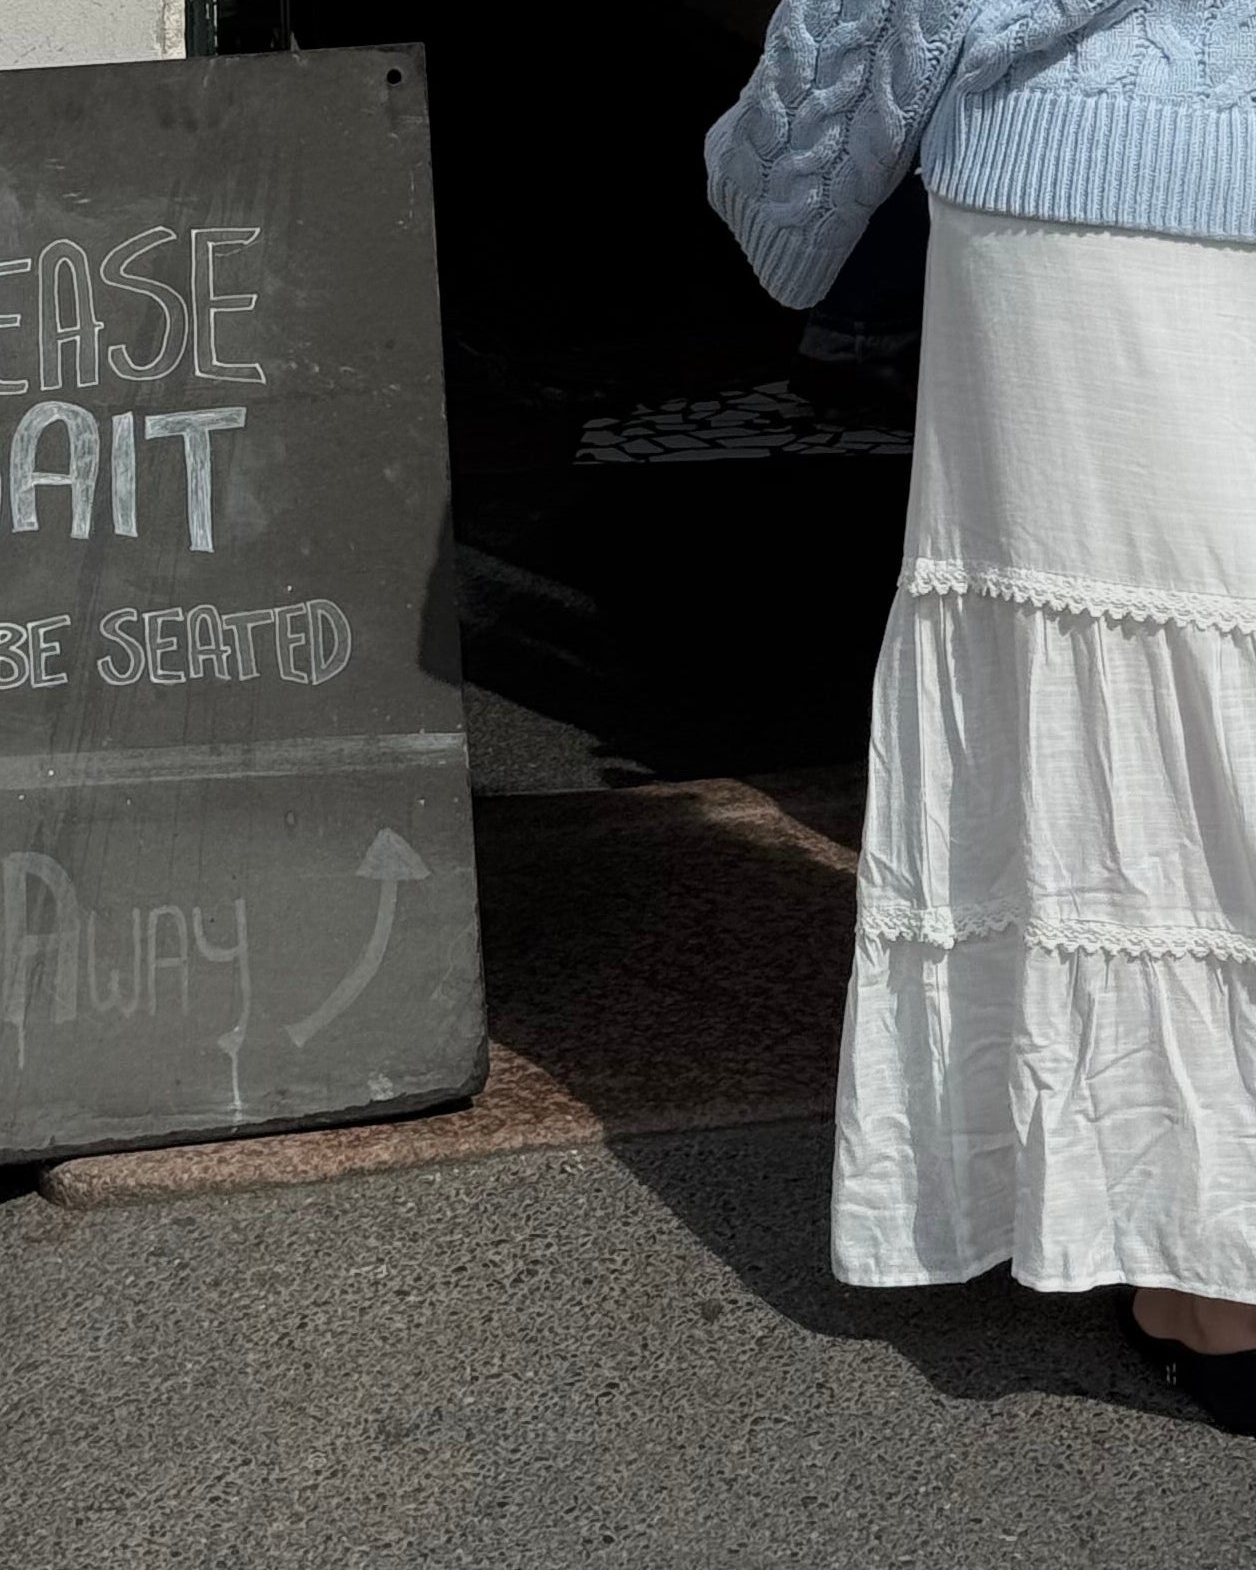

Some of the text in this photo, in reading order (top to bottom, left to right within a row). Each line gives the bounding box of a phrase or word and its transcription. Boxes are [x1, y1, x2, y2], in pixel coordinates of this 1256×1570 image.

[9, 400, 247, 553] AIT
[0, 599, 352, 690] BE SEATED
